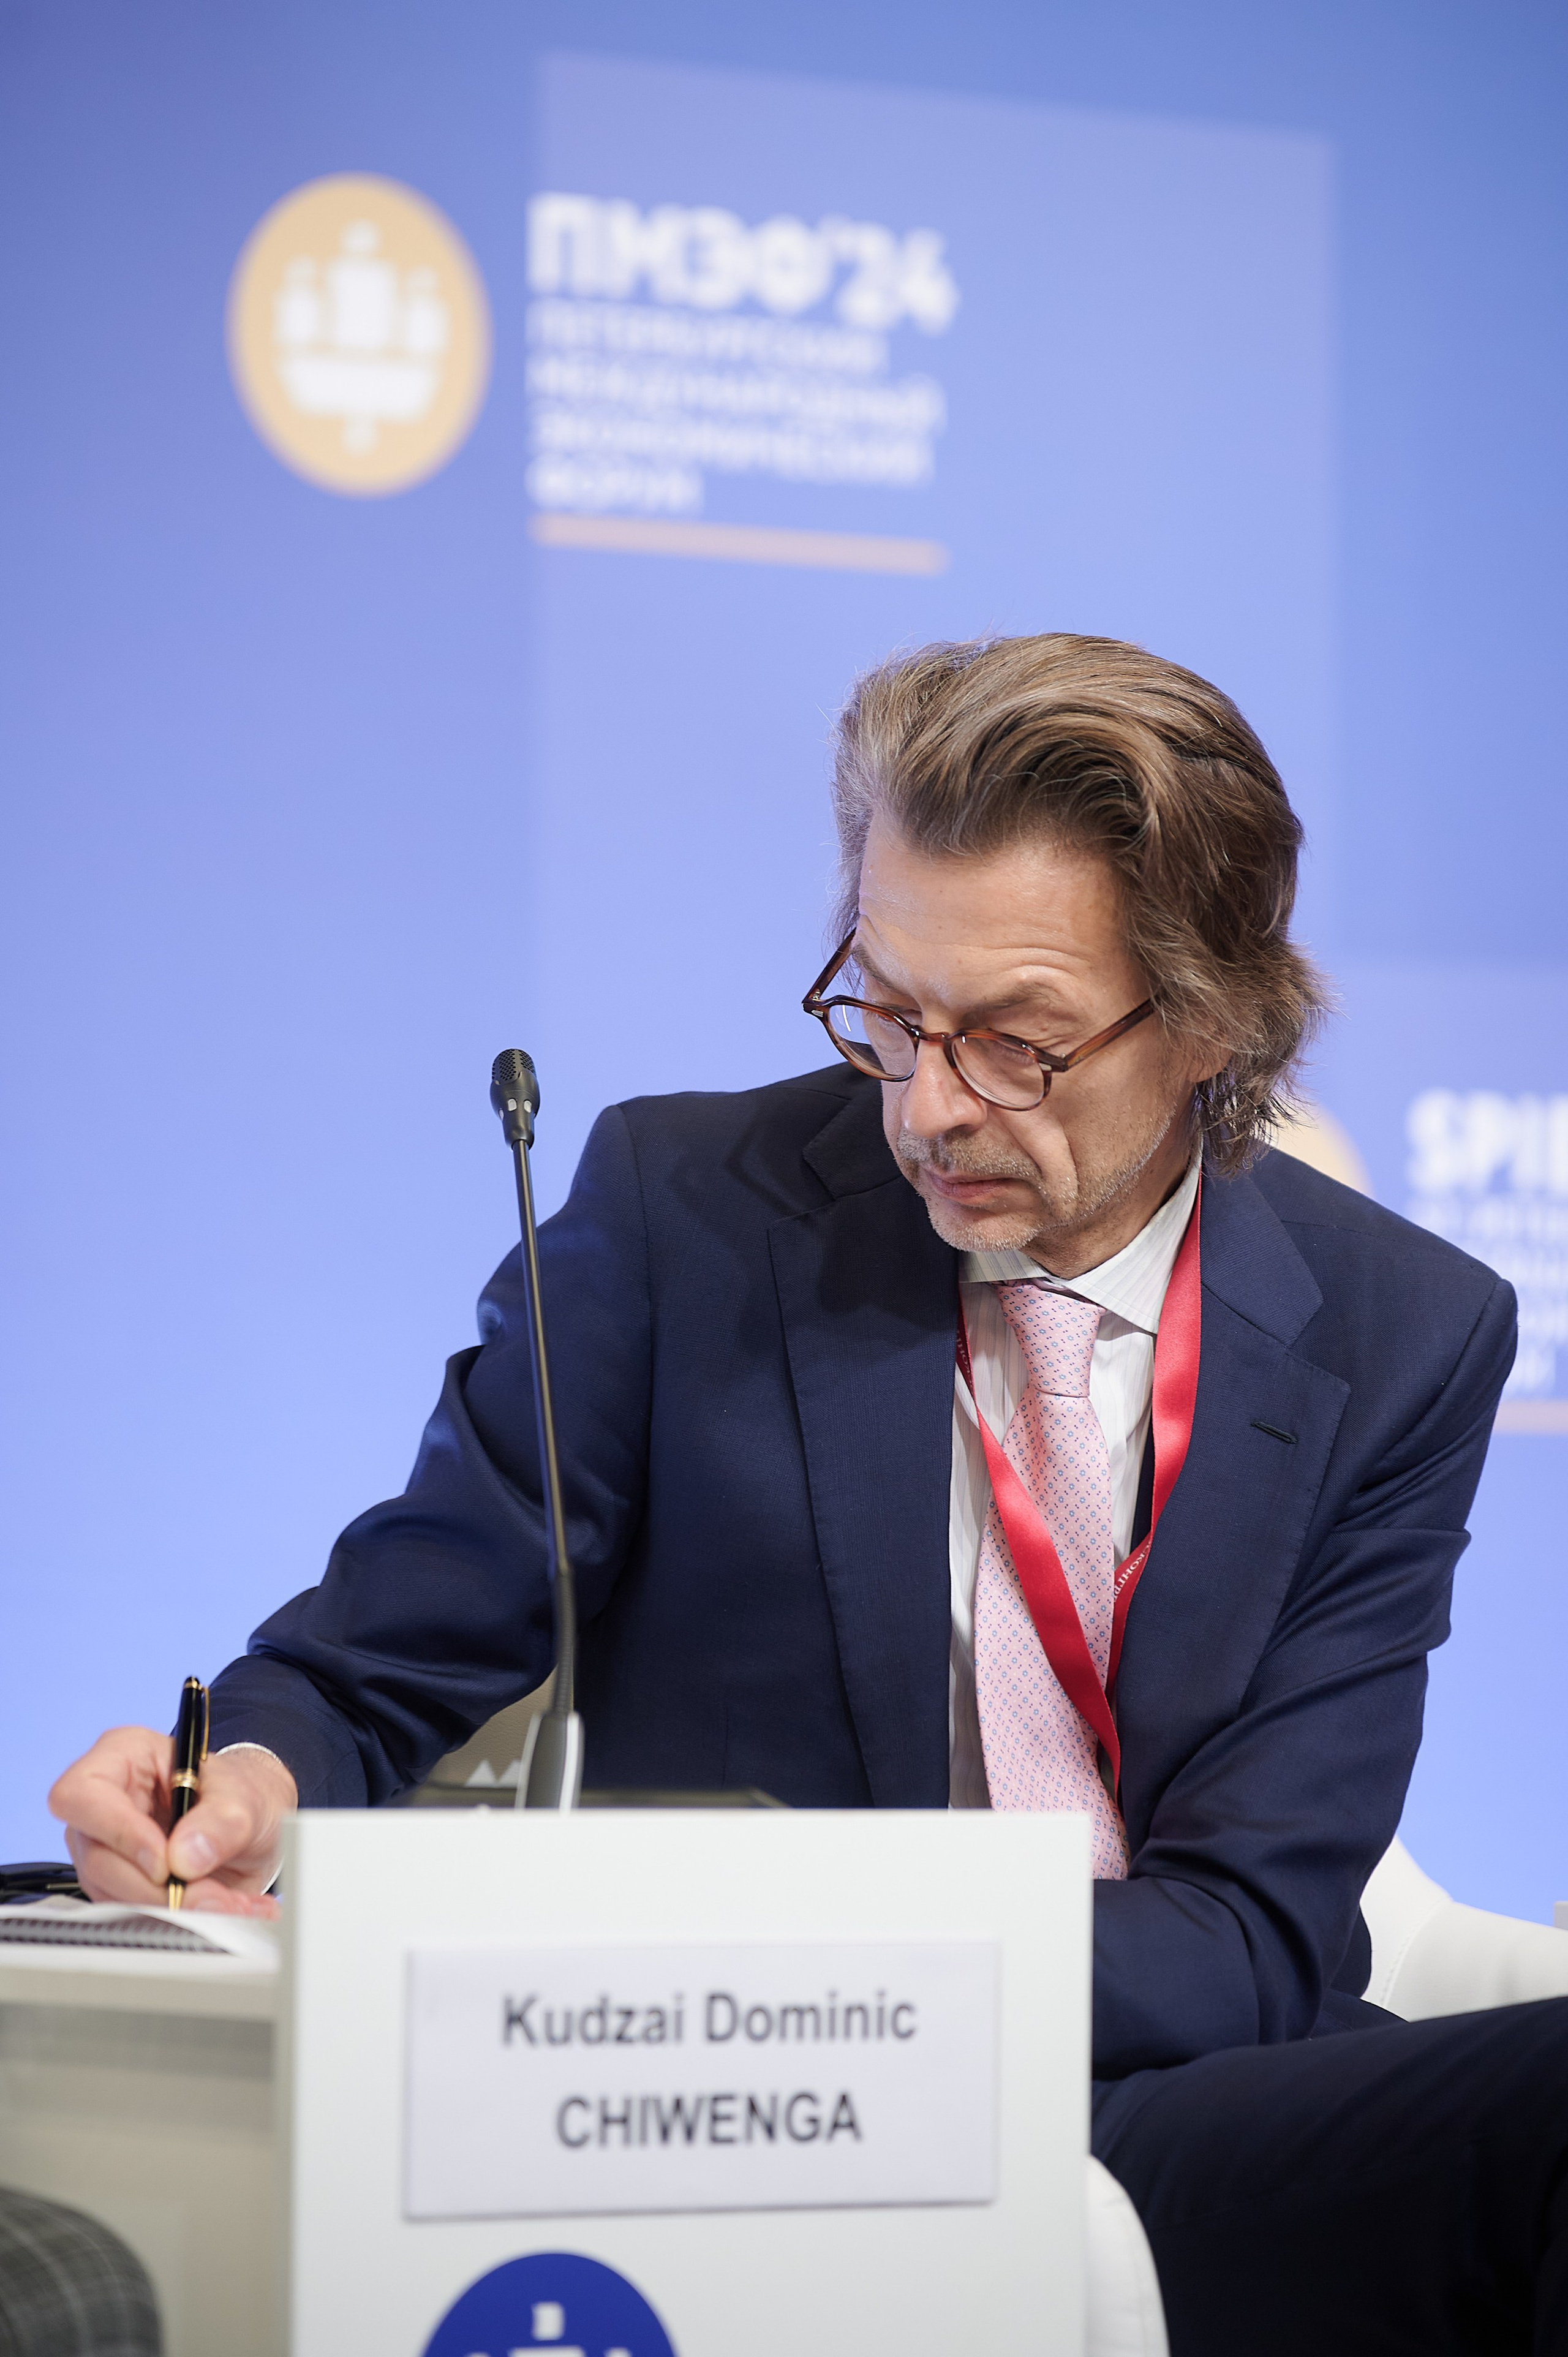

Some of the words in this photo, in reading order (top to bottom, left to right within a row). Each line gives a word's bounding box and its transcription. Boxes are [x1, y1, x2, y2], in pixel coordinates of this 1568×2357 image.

[502, 1993, 684, 2046] Kudzai
[704, 1989, 917, 2043] Dominic
[555, 2090, 862, 2150] CHIWENGA
